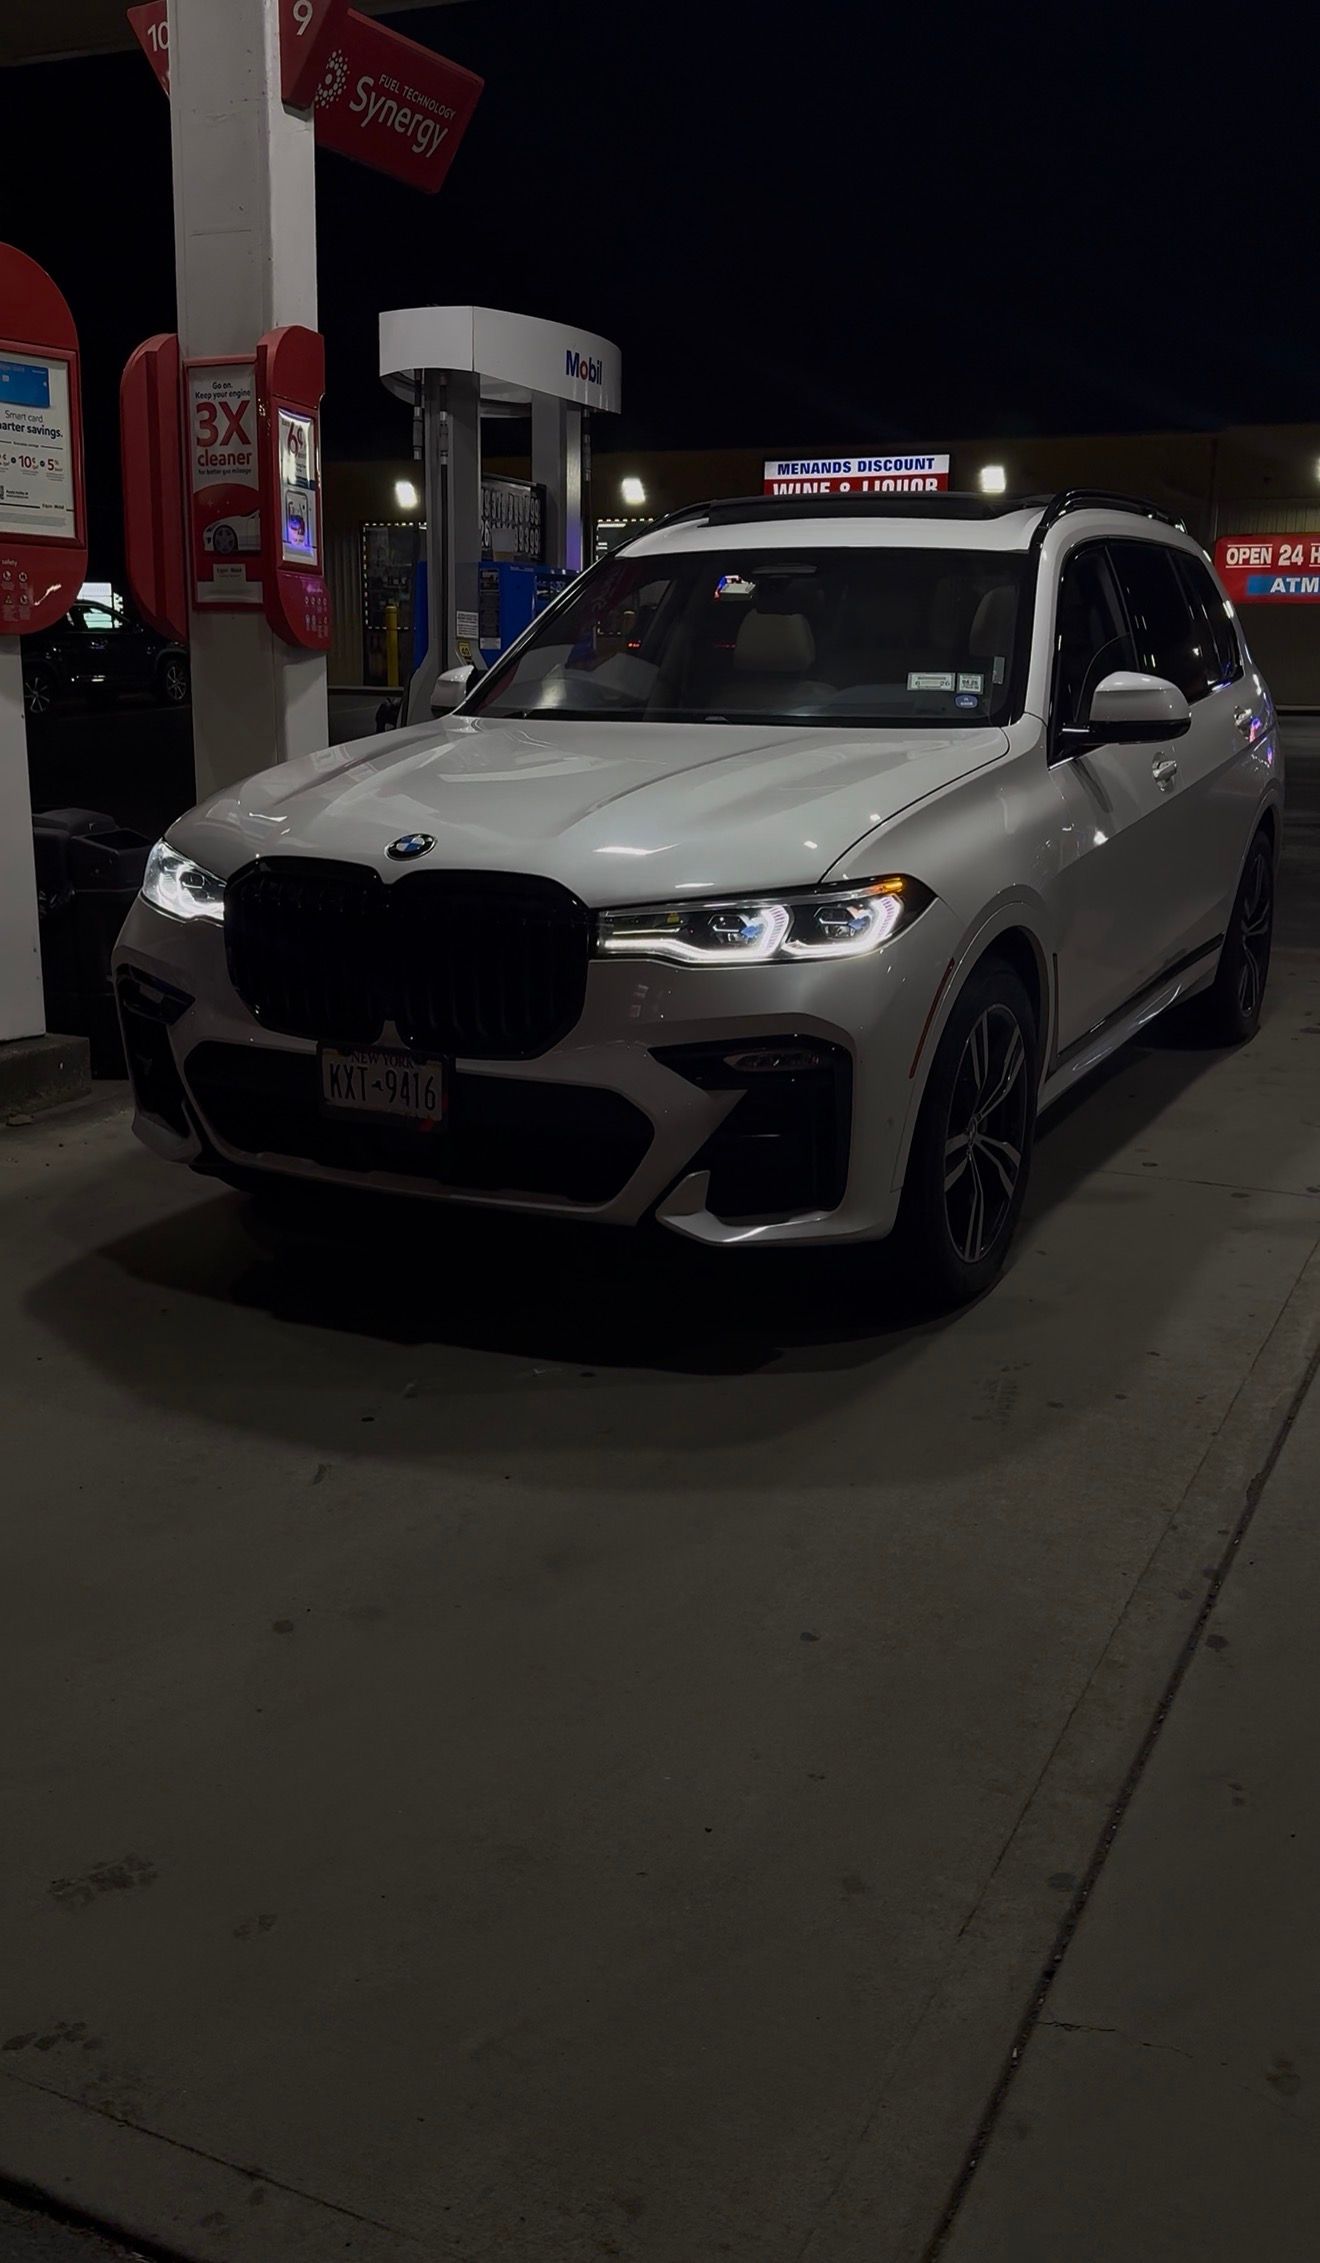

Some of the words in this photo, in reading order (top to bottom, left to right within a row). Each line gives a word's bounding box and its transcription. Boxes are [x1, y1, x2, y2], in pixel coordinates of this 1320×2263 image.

[292, 0, 314, 36] 9
[147, 21, 169, 52] 10
[378, 73, 400, 94] FUEL
[402, 85, 457, 121] TECHNOLOGY
[350, 75, 449, 158] Synergy
[566, 350, 603, 386] Mobil
[195, 391, 212, 401] Keep
[213, 391, 228, 400] your
[229, 388, 251, 399] engine
[212, 382, 222, 390] Go
[4, 409, 26, 421] Smart
[196, 400, 252, 448] 3X
[26, 424, 63, 440] savings.
[197, 448, 253, 467] cleaner
[777, 460, 852, 476] MENANDS
[857, 457, 936, 473] DISCOUNT
[1226, 546, 1273, 566] OPEN
[1278, 544, 1304, 567] 24
[1269, 577, 1320, 593] ATM
[351, 1050, 379, 1065] NEW
[381, 1054, 414, 1069] YORK
[330, 1063, 368, 1102] KXT
[385, 1069, 436, 1111] 9416
